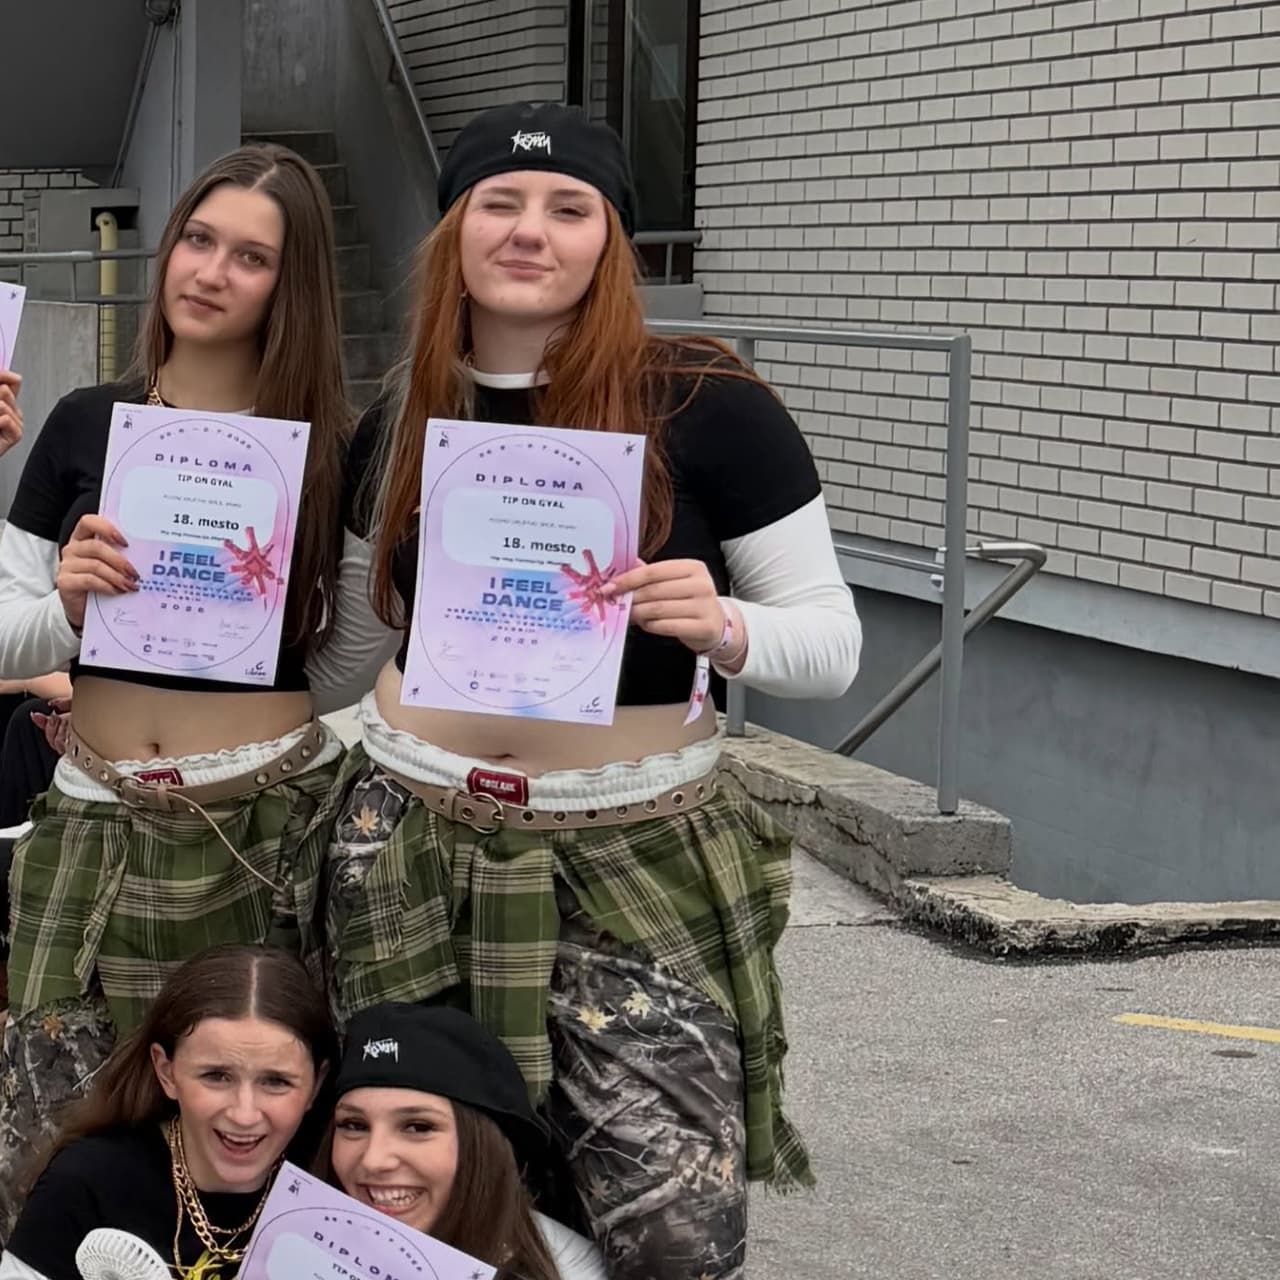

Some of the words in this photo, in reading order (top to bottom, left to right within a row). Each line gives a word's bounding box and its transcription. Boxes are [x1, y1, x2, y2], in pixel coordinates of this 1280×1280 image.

[154, 453, 253, 472] DIPLOMA
[475, 473, 584, 491] DIPLOMA
[173, 513, 194, 526] 18.
[198, 516, 239, 531] mesto
[503, 536, 525, 550] 18.
[530, 540, 576, 554] mesto
[169, 551, 221, 568] FEEL
[152, 564, 226, 583] DANCE
[500, 578, 558, 595] FEEL
[481, 592, 564, 612] DANCE
